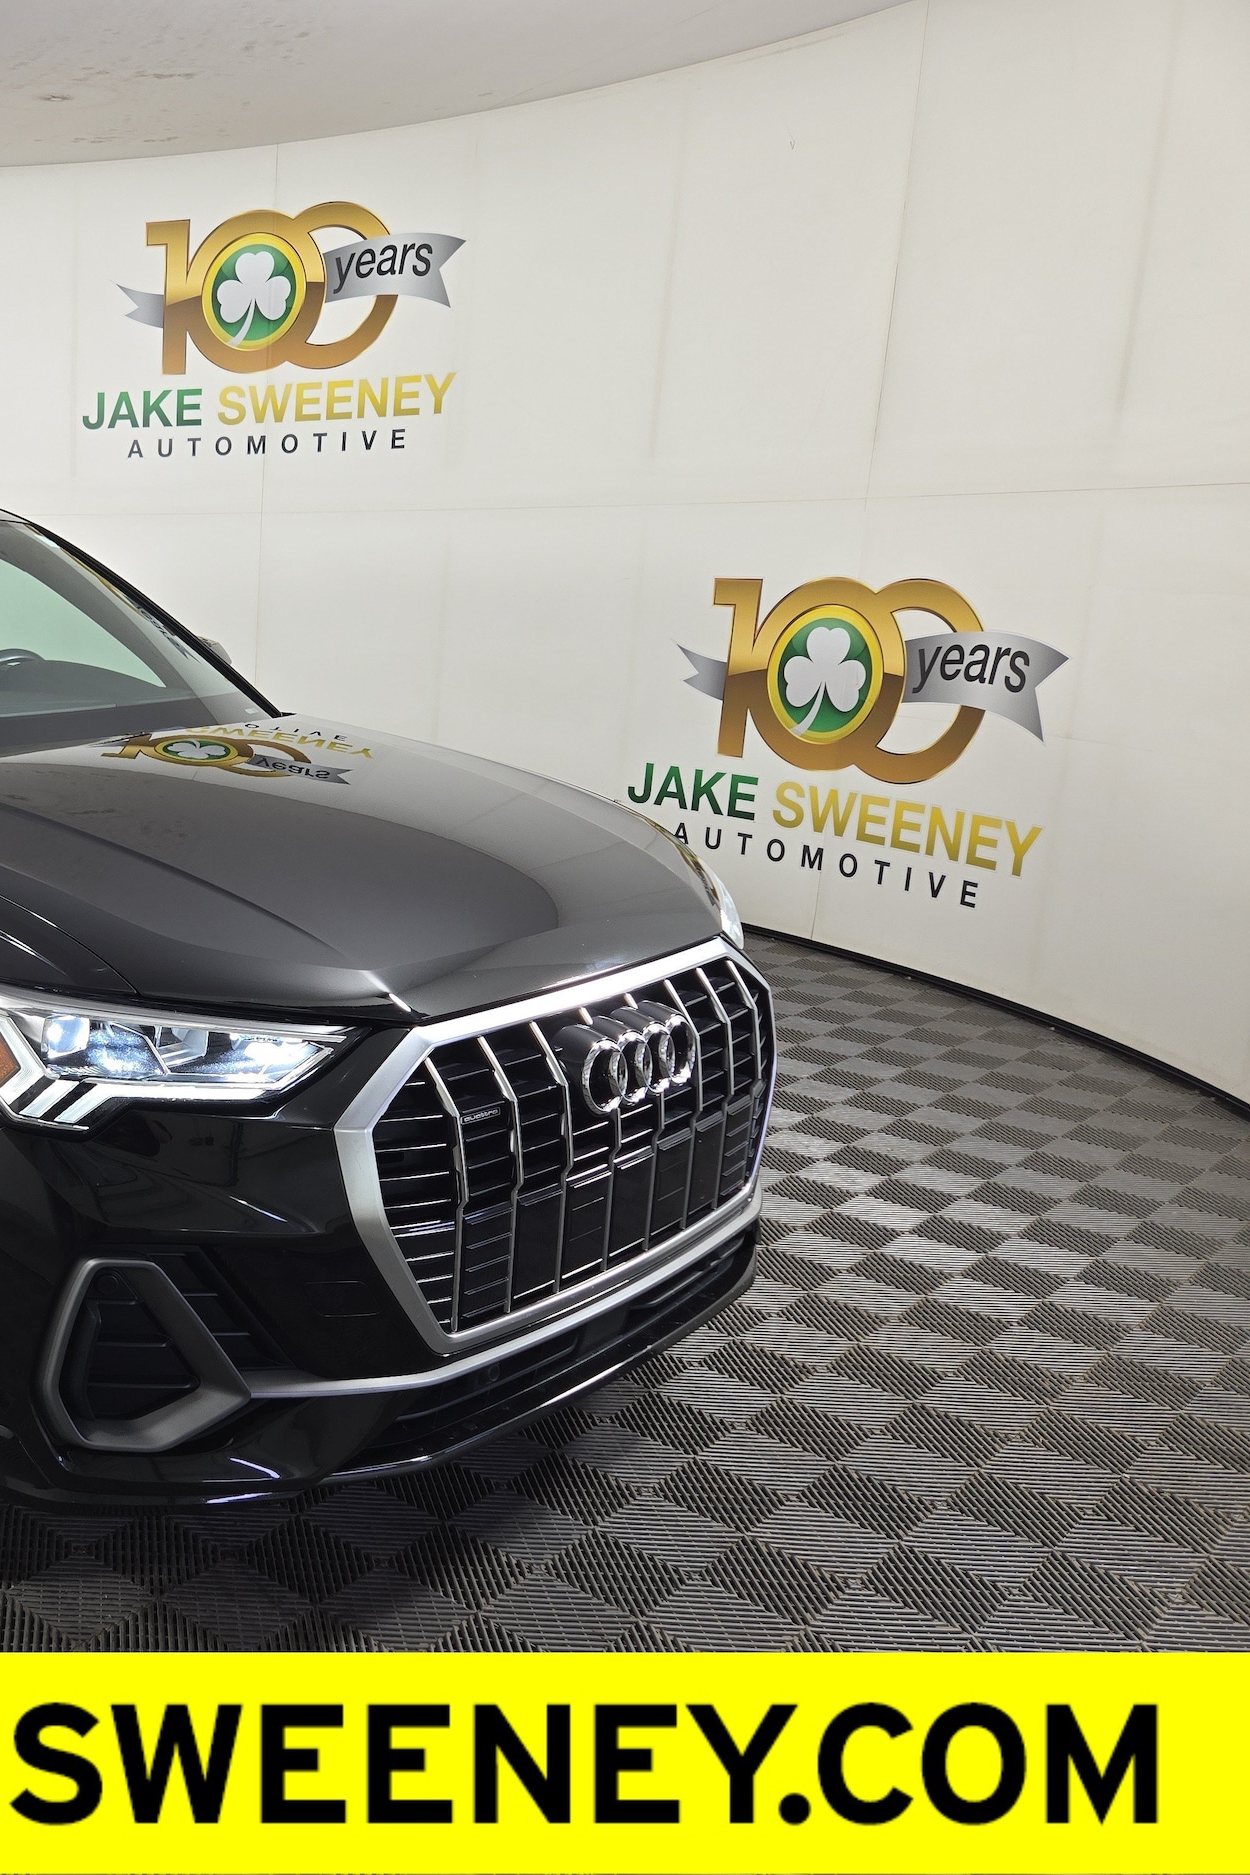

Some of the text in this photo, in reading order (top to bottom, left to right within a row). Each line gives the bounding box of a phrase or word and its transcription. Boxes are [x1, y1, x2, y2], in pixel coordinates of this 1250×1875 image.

[145, 201, 432, 375] 100 years
[82, 372, 457, 430] JAKE SWEENEY
[127, 429, 406, 458] AUTOMOTIVE
[713, 577, 1030, 784] 100 years
[627, 762, 1043, 877] JAKE SWEENEY
[673, 822, 978, 909] AUTOMOTIVE
